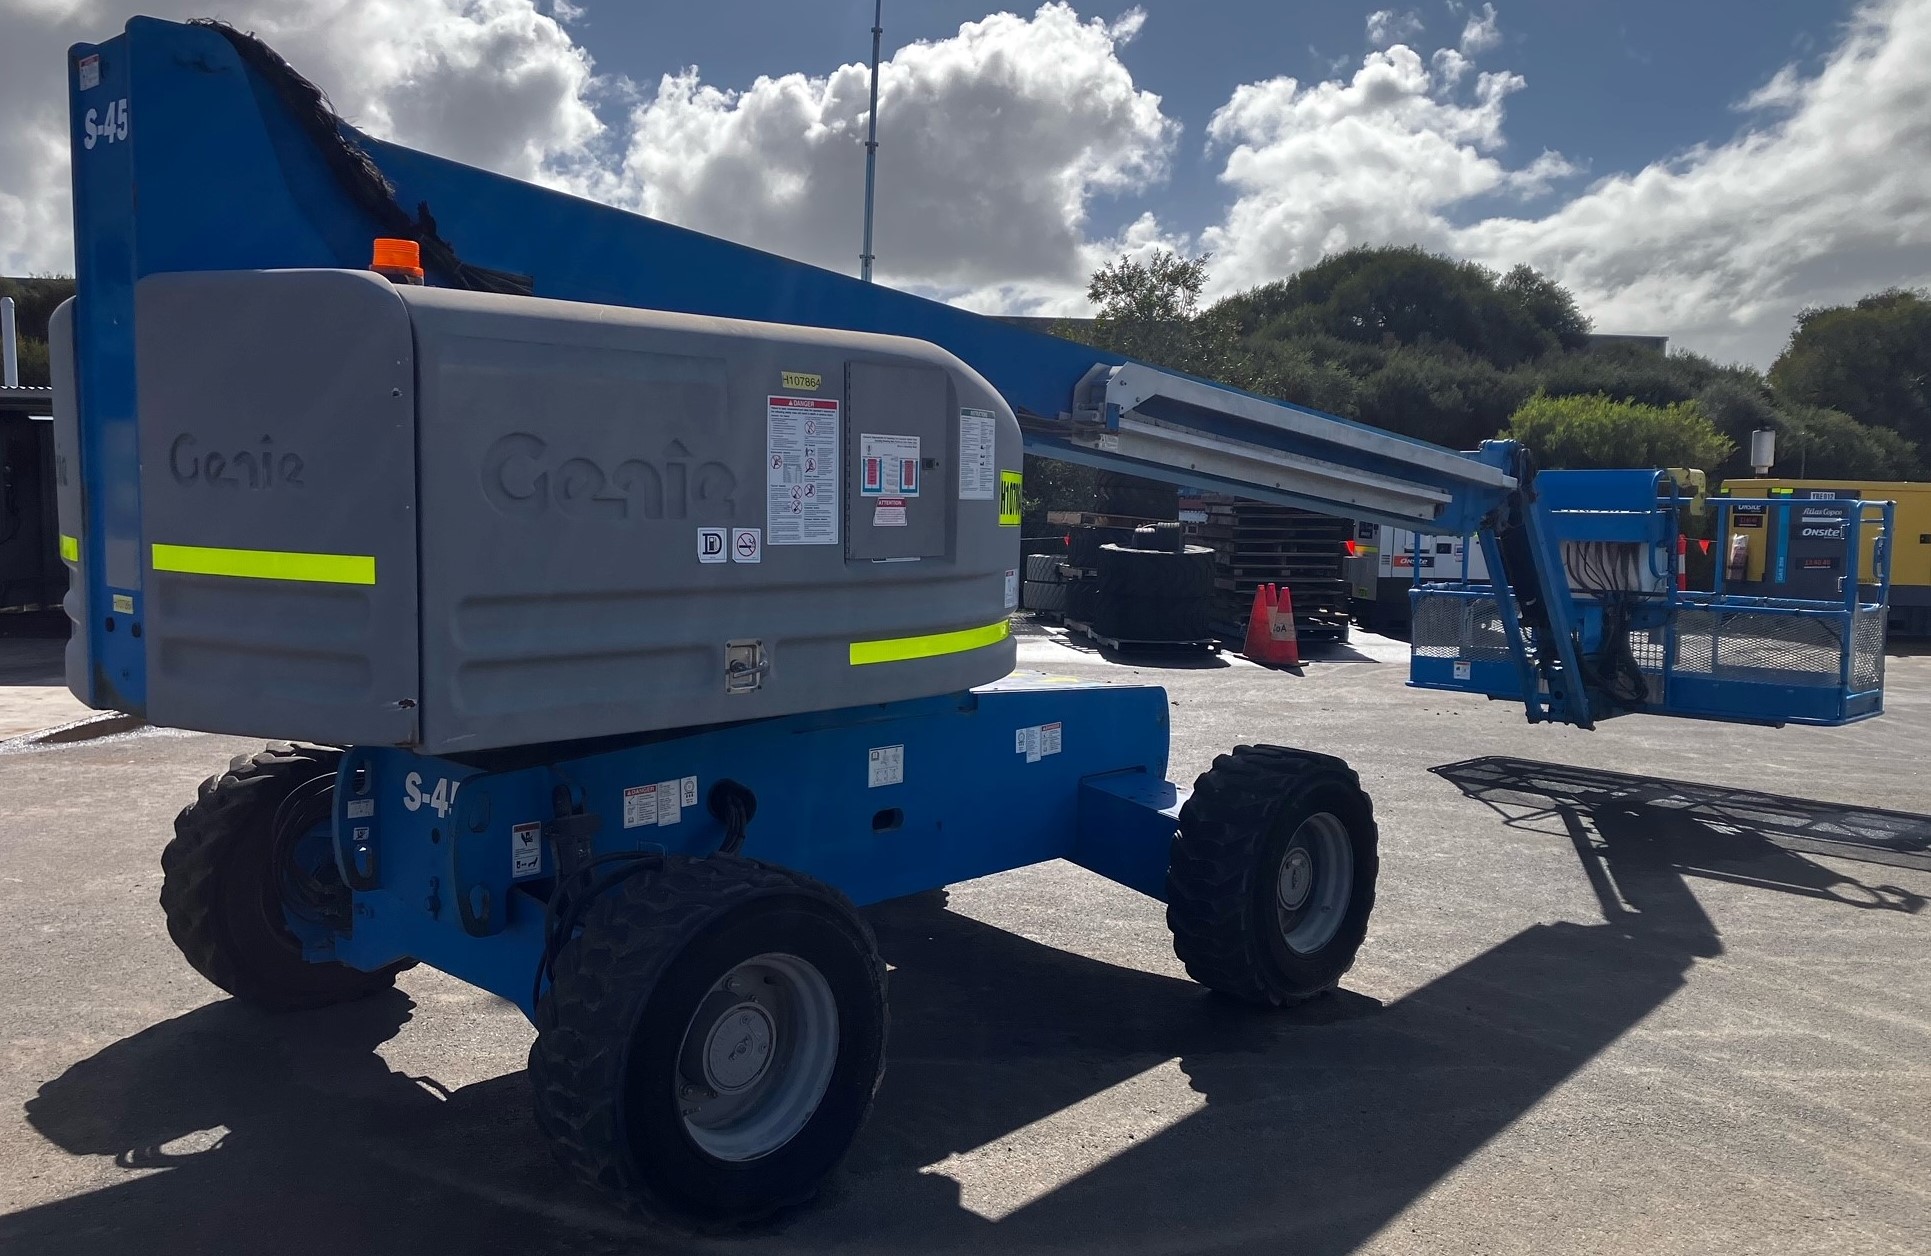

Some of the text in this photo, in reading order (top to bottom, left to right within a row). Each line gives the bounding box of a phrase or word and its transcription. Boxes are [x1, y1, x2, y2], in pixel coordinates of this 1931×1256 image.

[84, 99, 128, 150] S-45
[793, 400, 815, 408] DANGER
[170, 433, 305, 490] Genie
[480, 432, 738, 519] Genie
[1802, 507, 1842, 517] Atlas Copco
[632, 786, 655, 795] DANGER
